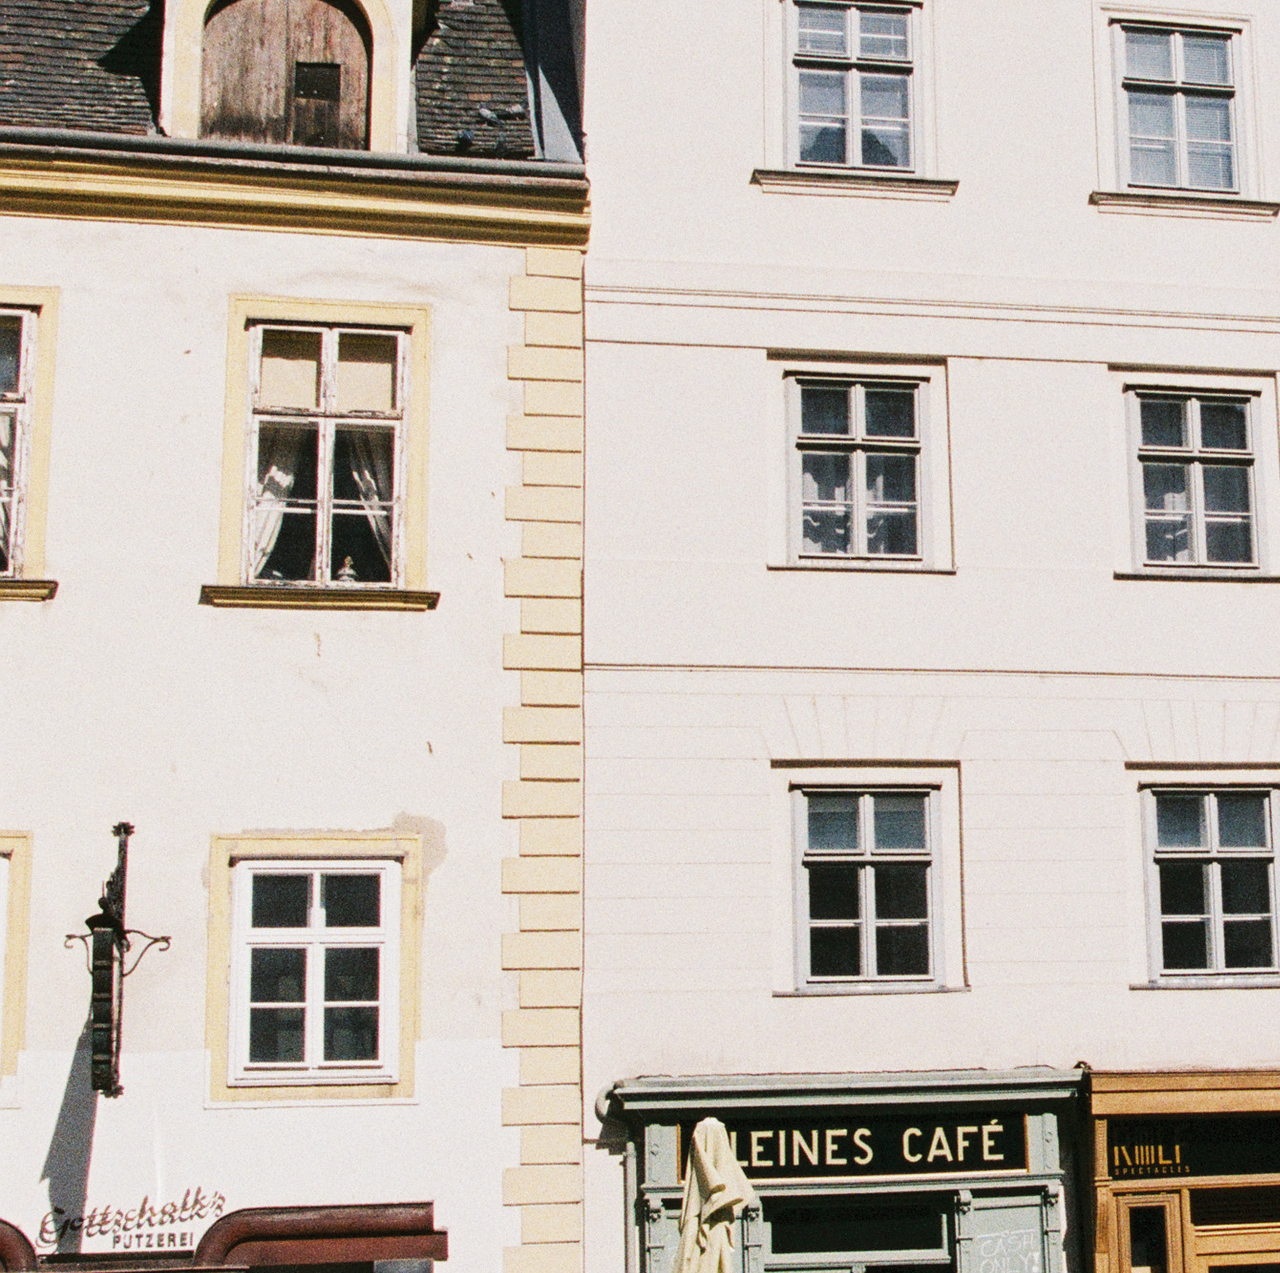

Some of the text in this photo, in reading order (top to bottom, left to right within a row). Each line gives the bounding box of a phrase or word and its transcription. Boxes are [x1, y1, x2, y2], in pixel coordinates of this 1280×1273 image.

[730, 1118, 1005, 1167] LEINES CAFÉ
[1114, 1165, 1190, 1176] SPECTACLES
[112, 1232, 195, 1250] PUTZEREI
[980, 1234, 1035, 1258] CASH
